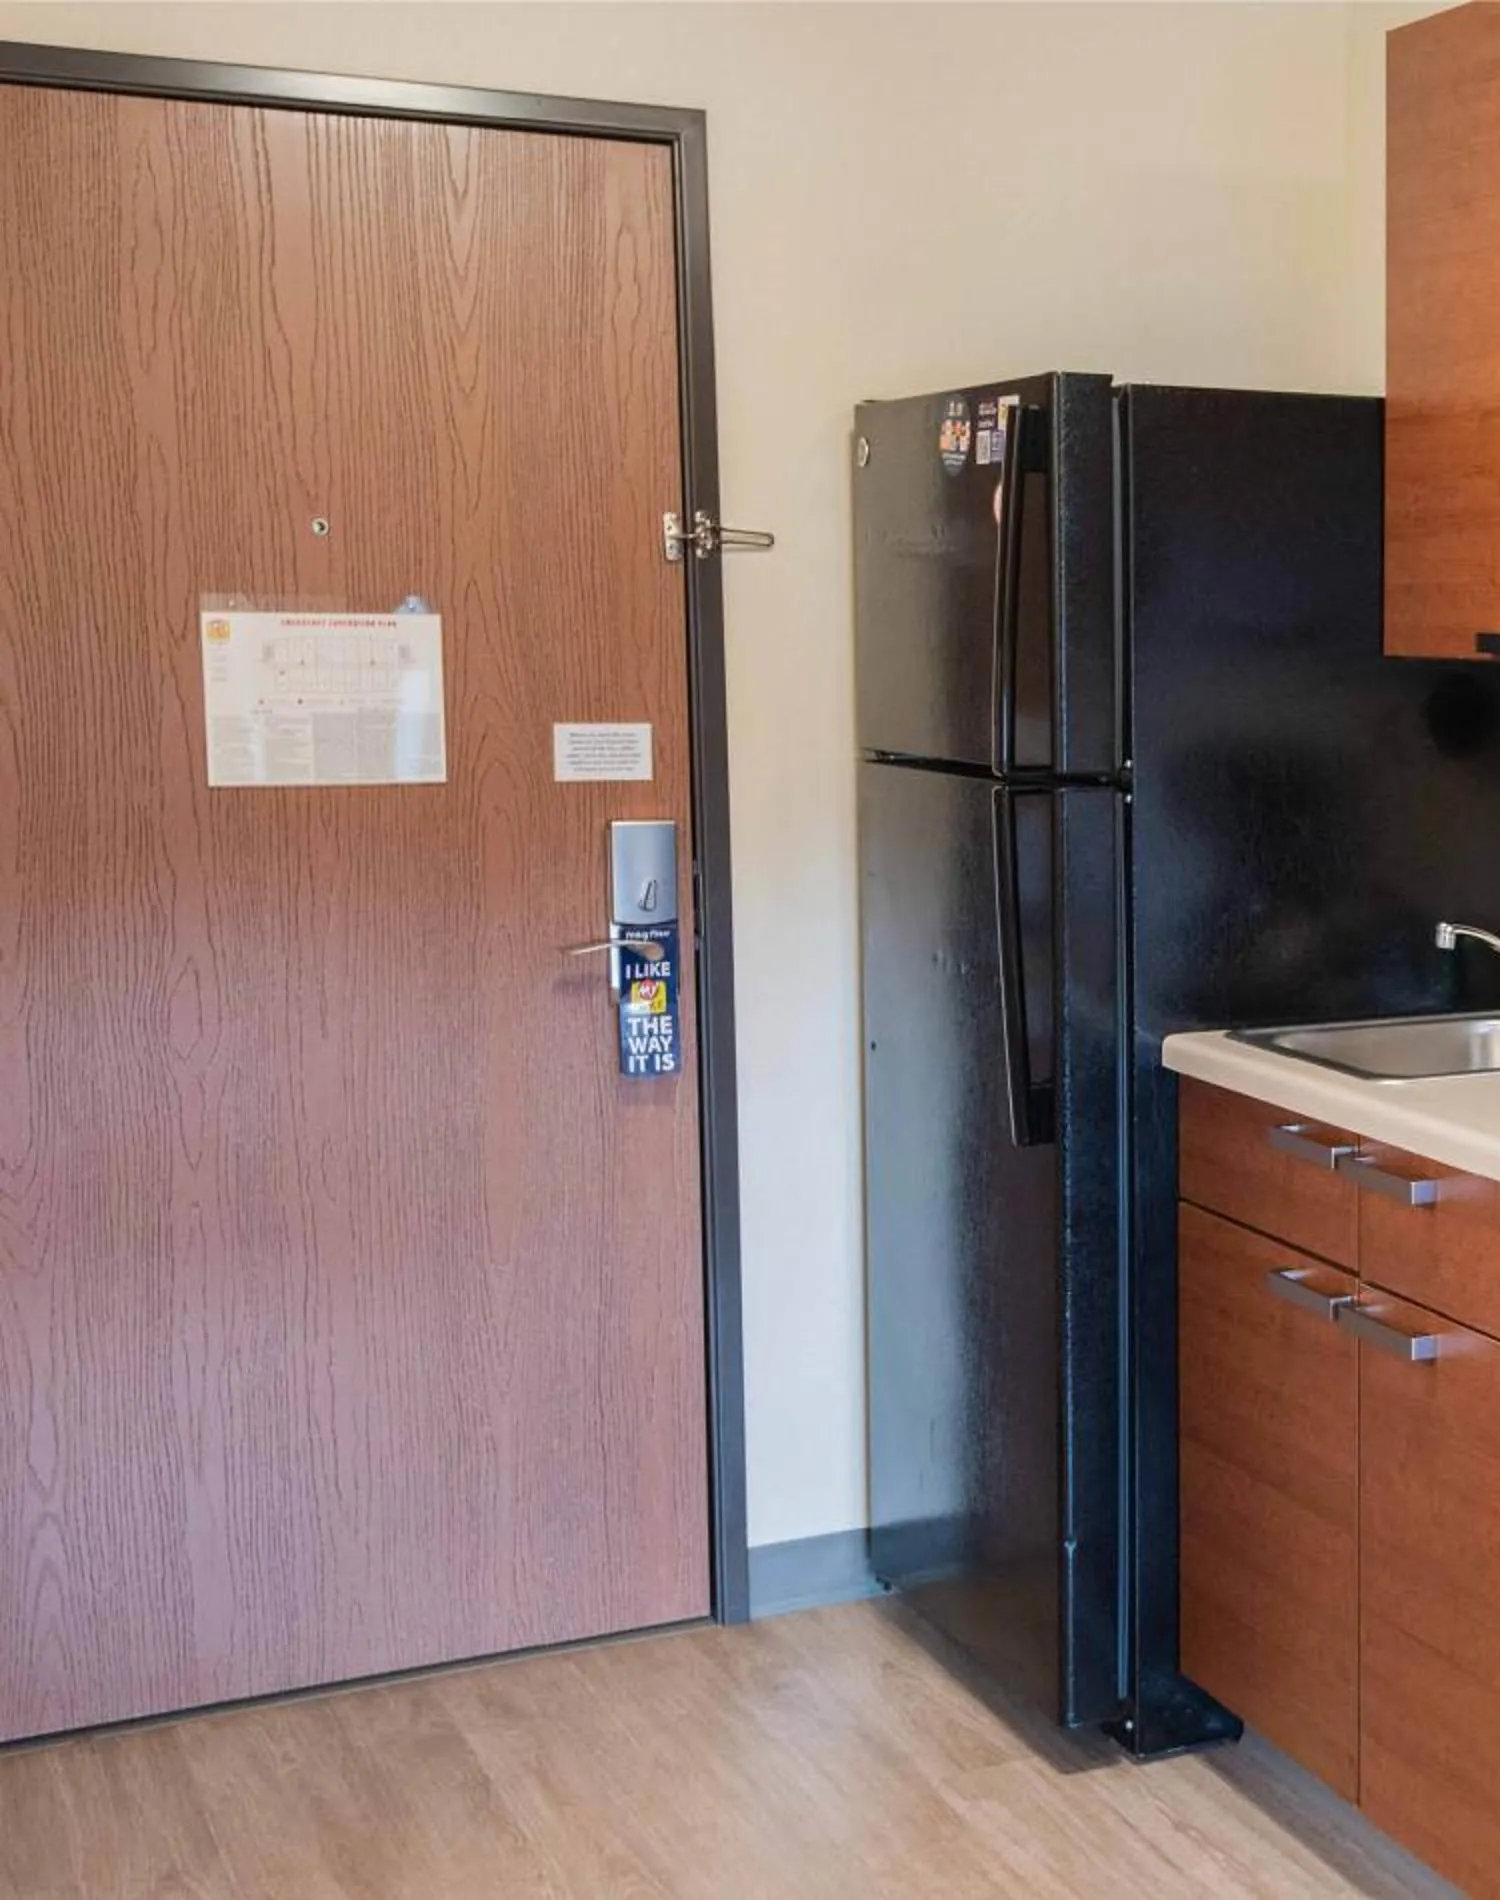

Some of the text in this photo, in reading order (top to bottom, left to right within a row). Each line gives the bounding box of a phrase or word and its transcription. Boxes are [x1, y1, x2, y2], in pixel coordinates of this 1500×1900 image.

[635, 961, 671, 979] LIKE
[627, 1015, 673, 1037] THE
[627, 1035, 673, 1055] WAY
[628, 1053, 675, 1073] IT IS
